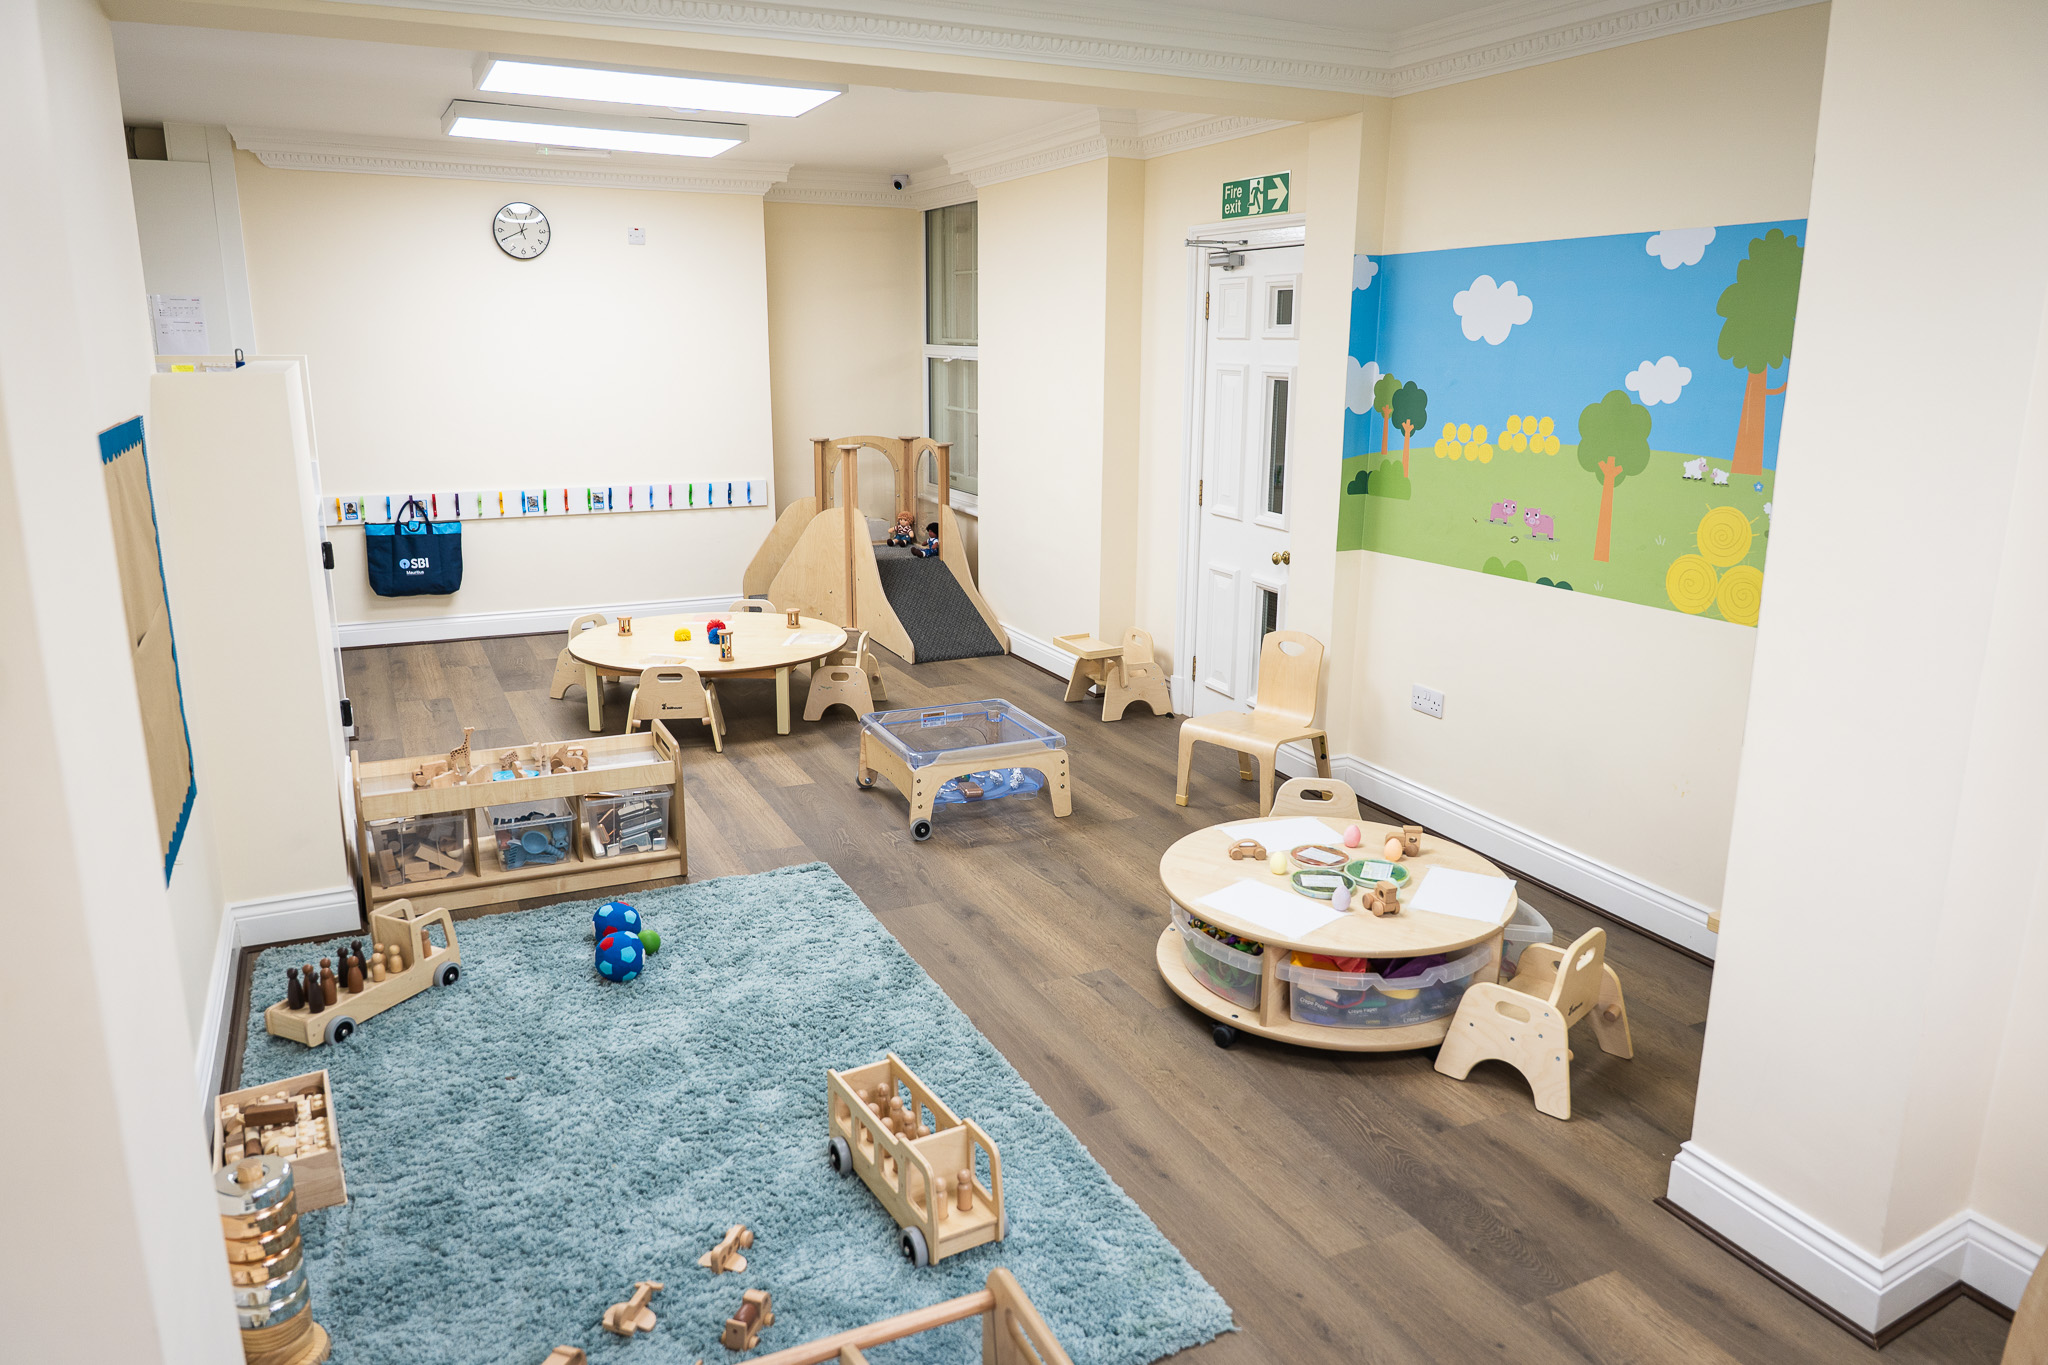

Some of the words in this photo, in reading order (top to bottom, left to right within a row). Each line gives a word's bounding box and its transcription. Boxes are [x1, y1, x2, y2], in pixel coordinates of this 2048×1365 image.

[1225, 185, 1242, 199] Fire
[1224, 200, 1241, 214] exit
[410, 558, 429, 569] SBI
[1314, 1001, 1328, 1010] Paper
